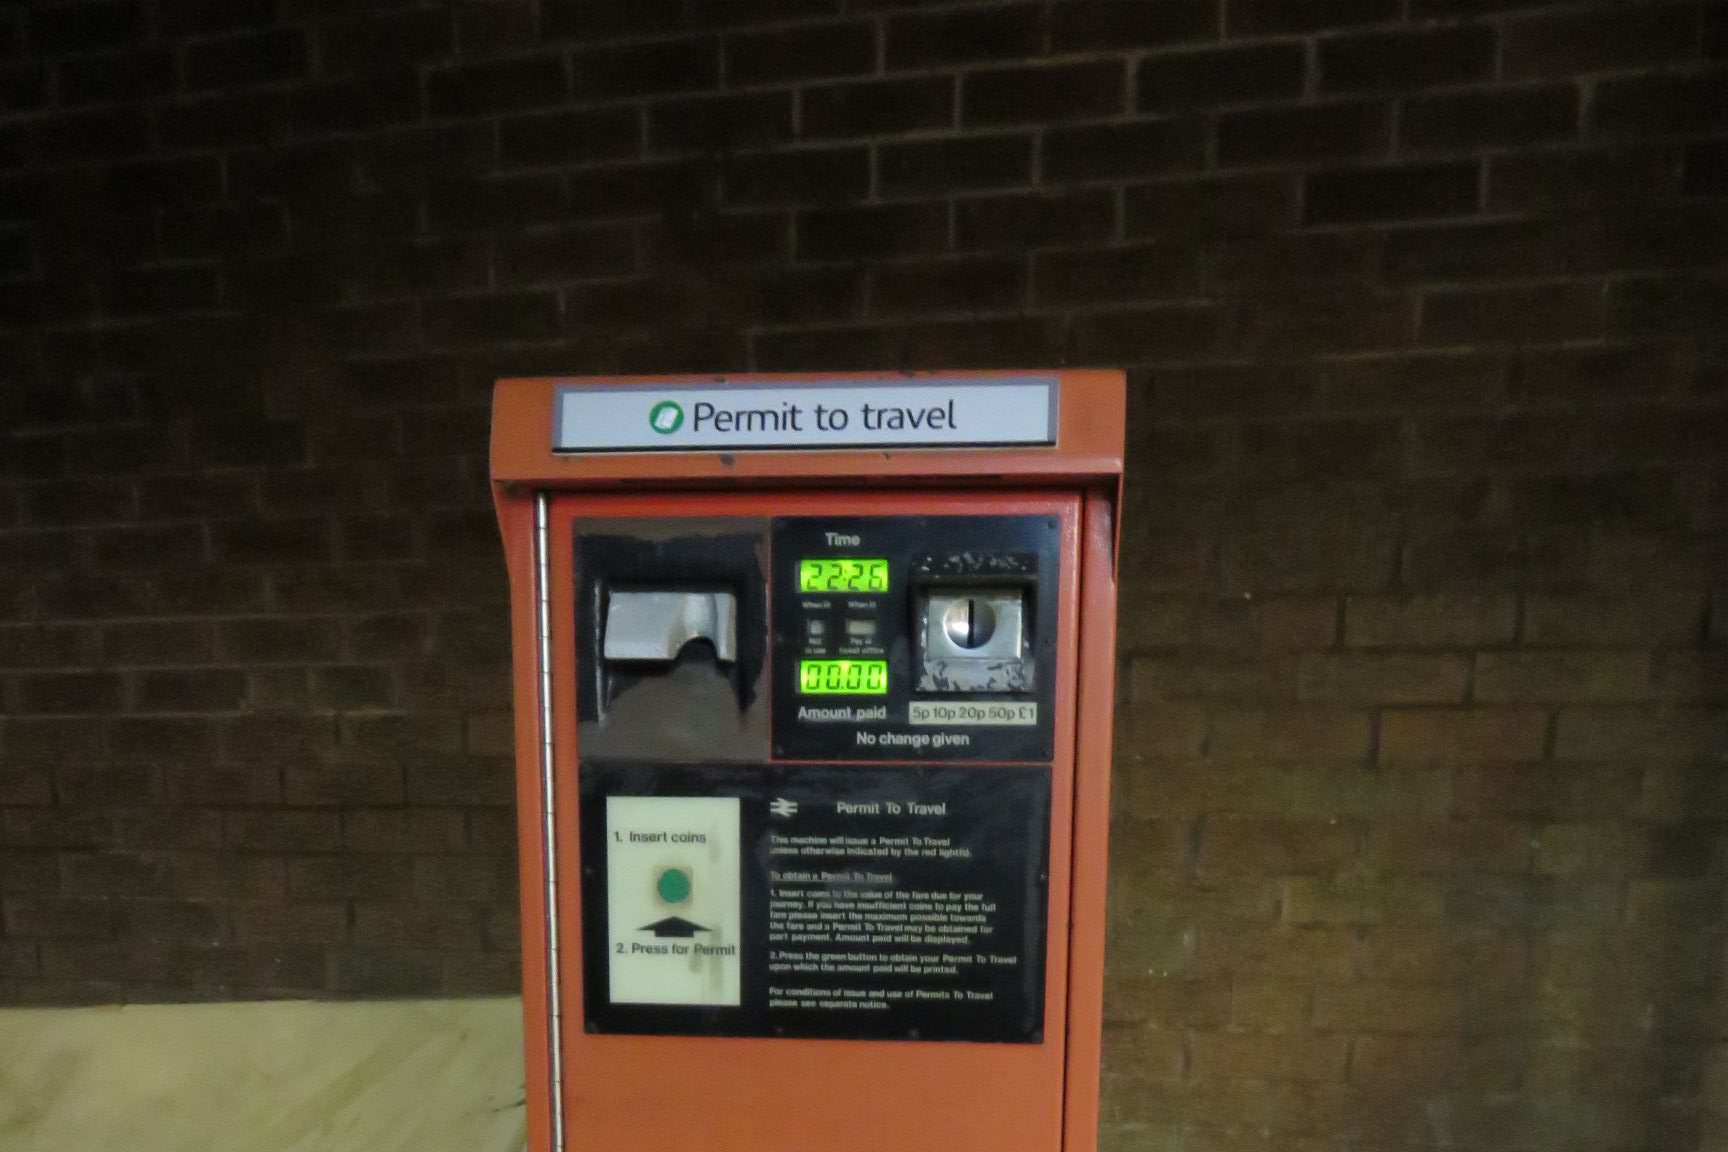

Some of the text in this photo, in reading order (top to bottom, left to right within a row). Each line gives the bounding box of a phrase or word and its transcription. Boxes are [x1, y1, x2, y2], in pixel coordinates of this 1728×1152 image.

[693, 399, 957, 432] Permit to travel
[825, 532, 860, 546] Time
[806, 563, 883, 591] 22:26
[806, 664, 884, 691] 00.00
[798, 706, 886, 722] Amount paid
[913, 707, 930, 721] 5p
[933, 707, 956, 721] 10p
[959, 707, 986, 721] 20p
[989, 707, 1016, 721] 50p
[856, 731, 970, 748] No change given
[837, 801, 946, 815] Permit To Travel
[614, 831, 707, 843] 1. Insert coins
[771, 835, 789, 844] This
[790, 836, 827, 846] machine
[829, 836, 844, 846] will
[845, 836, 869, 846] issue
[879, 836, 909, 846] Permit
[912, 836, 922, 846] To
[924, 836, 950, 846] Travel
[769, 847, 799, 855] unless
[801, 847, 845, 855] otherwise
[846, 848, 888, 857] indicated
[890, 848, 901, 857] by
[904, 848, 919, 856] the
[922, 848, 936, 856] red
[770, 871, 780, 880] To
[782, 871, 811, 880] obtain
[821, 871, 850, 881] Permit
[854, 871, 865, 881] To
[867, 872, 893, 882] Travel
[770, 889, 983, 901] 1. Insert coins to the value of the fare due for your
[816, 902, 832, 911] you
[834, 902, 855, 910] have
[857, 902, 907, 911] insufficient
[909, 903, 933, 911] coins
[935, 903, 944, 911] to
[946, 905, 962, 913] pay
[964, 904, 979, 912] the
[981, 904, 996, 912] full
[770, 911, 787, 919] fare
[788, 912, 818, 921] please
[820, 912, 845, 920] insert
[848, 912, 863, 920] the
[910, 913, 948, 922] possible
[950, 914, 987, 922] towards
[769, 922, 784, 930] the
[786, 922, 805, 930] fare
[806, 923, 823, 931] and
[833, 923, 862, 931] Permit
[864, 923, 875, 931] To
[877, 923, 903, 931] Travel
[938, 925, 978, 933] obtained
[980, 925, 993, 933] for
[769, 933, 788, 942] part
[835, 934, 870, 942] Amount
[872, 934, 892, 943] paid
[616, 942, 736, 956] 2. Press for Permit
[770, 951, 778, 959] 2.
[779, 952, 804, 960] Press
[805, 952, 820, 960] the
[821, 954, 847, 962] green
[890, 954, 918, 962] obtain
[942, 954, 973, 963] Permit
[976, 955, 987, 963] To
[990, 955, 1017, 964] Travel
[769, 963, 792, 972] upon
[793, 963, 819, 971] which
[821, 964, 835, 972] the
[837, 964, 870, 972] amount
[873, 964, 893, 973] paid
[769, 987, 783, 996] For
[785, 988, 831, 997] conditions
[832, 989, 841, 997] of
[844, 989, 866, 997] issue
[905, 990, 914, 998] of
[915, 990, 950, 999] Permits
[953, 991, 964, 999] To
[966, 991, 994, 1000] Travel
[769, 1000, 798, 1008] please
[800, 1000, 817, 1008] see
[819, 1000, 857, 1009] separate
